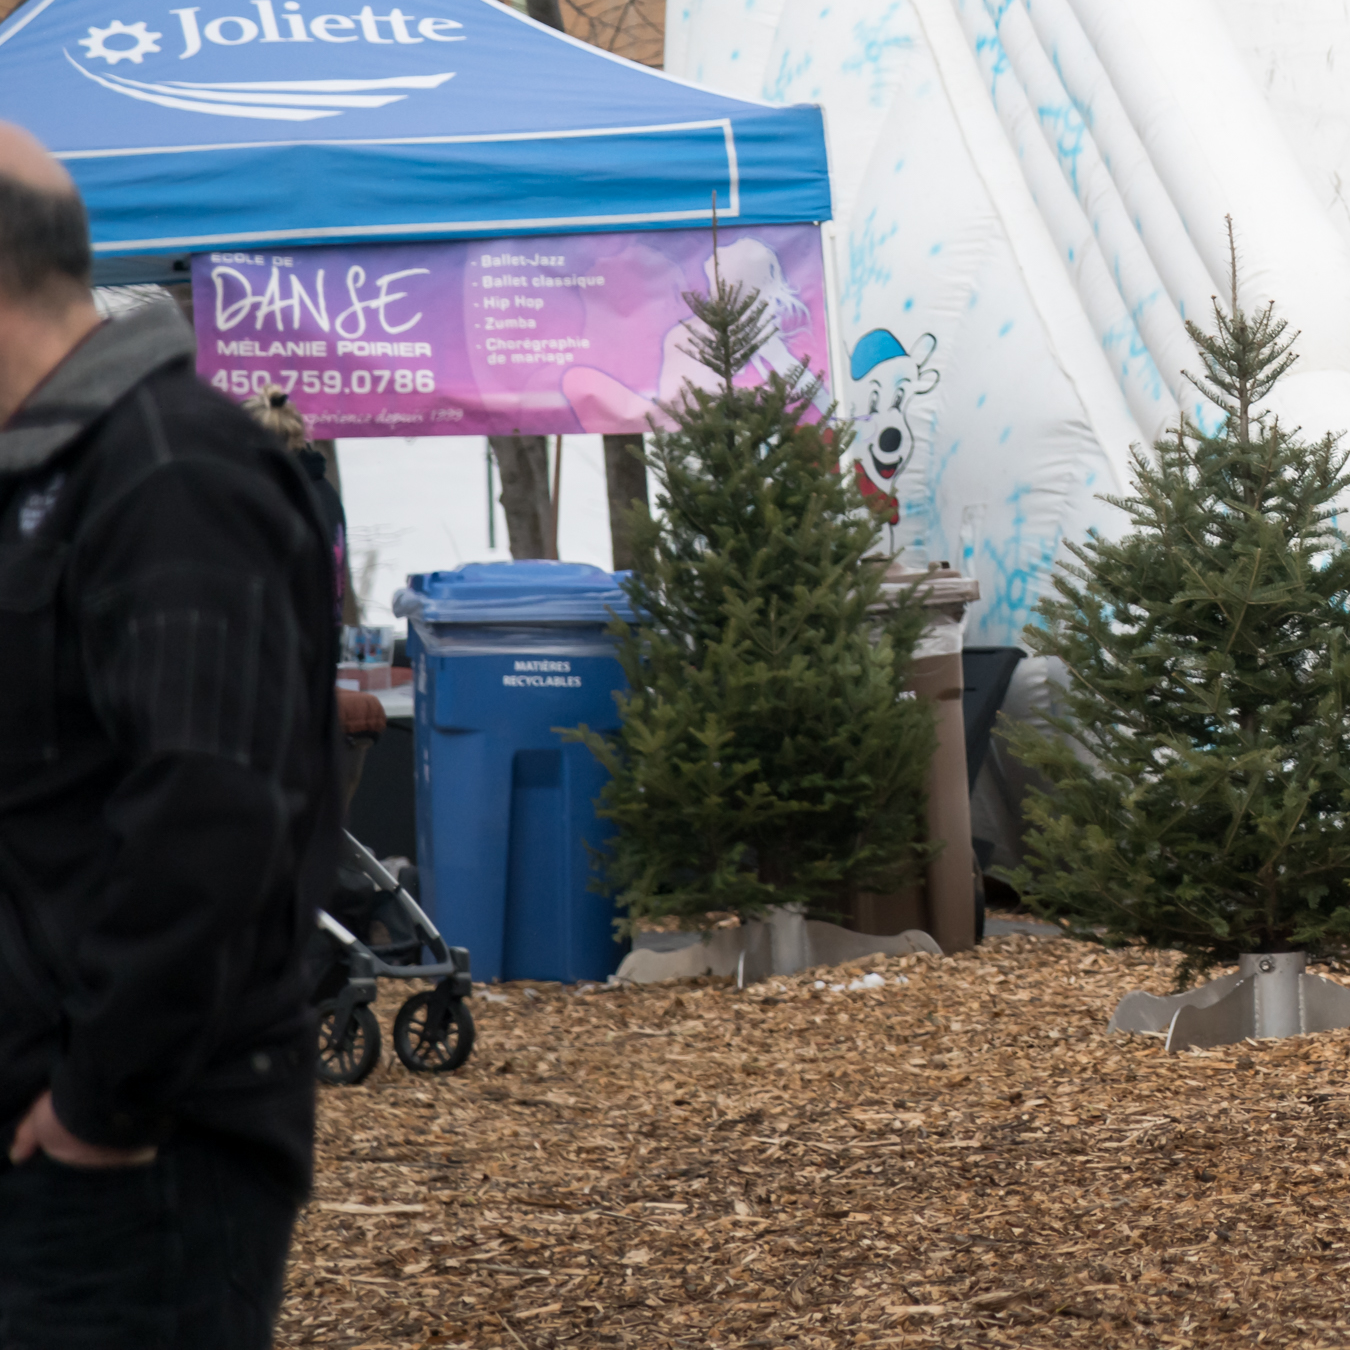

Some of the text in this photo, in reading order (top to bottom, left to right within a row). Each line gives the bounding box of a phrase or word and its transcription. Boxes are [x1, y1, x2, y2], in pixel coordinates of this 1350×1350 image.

[168, 0, 467, 60] Joliette
[272, 255, 293, 267] DE
[482, 274, 605, 289] Ballet classique
[211, 265, 431, 339] DANSE
[483, 295, 544, 311] Hip Hop
[484, 316, 537, 331] Zumba
[336, 341, 432, 358] POIRIER
[485, 336, 590, 352] Chorégraphie
[487, 352, 574, 365] de mariage
[211, 368, 435, 394] 450759.0786
[514, 659, 571, 673] MATIÈRES
[502, 675, 582, 688] RECYCLABLES
